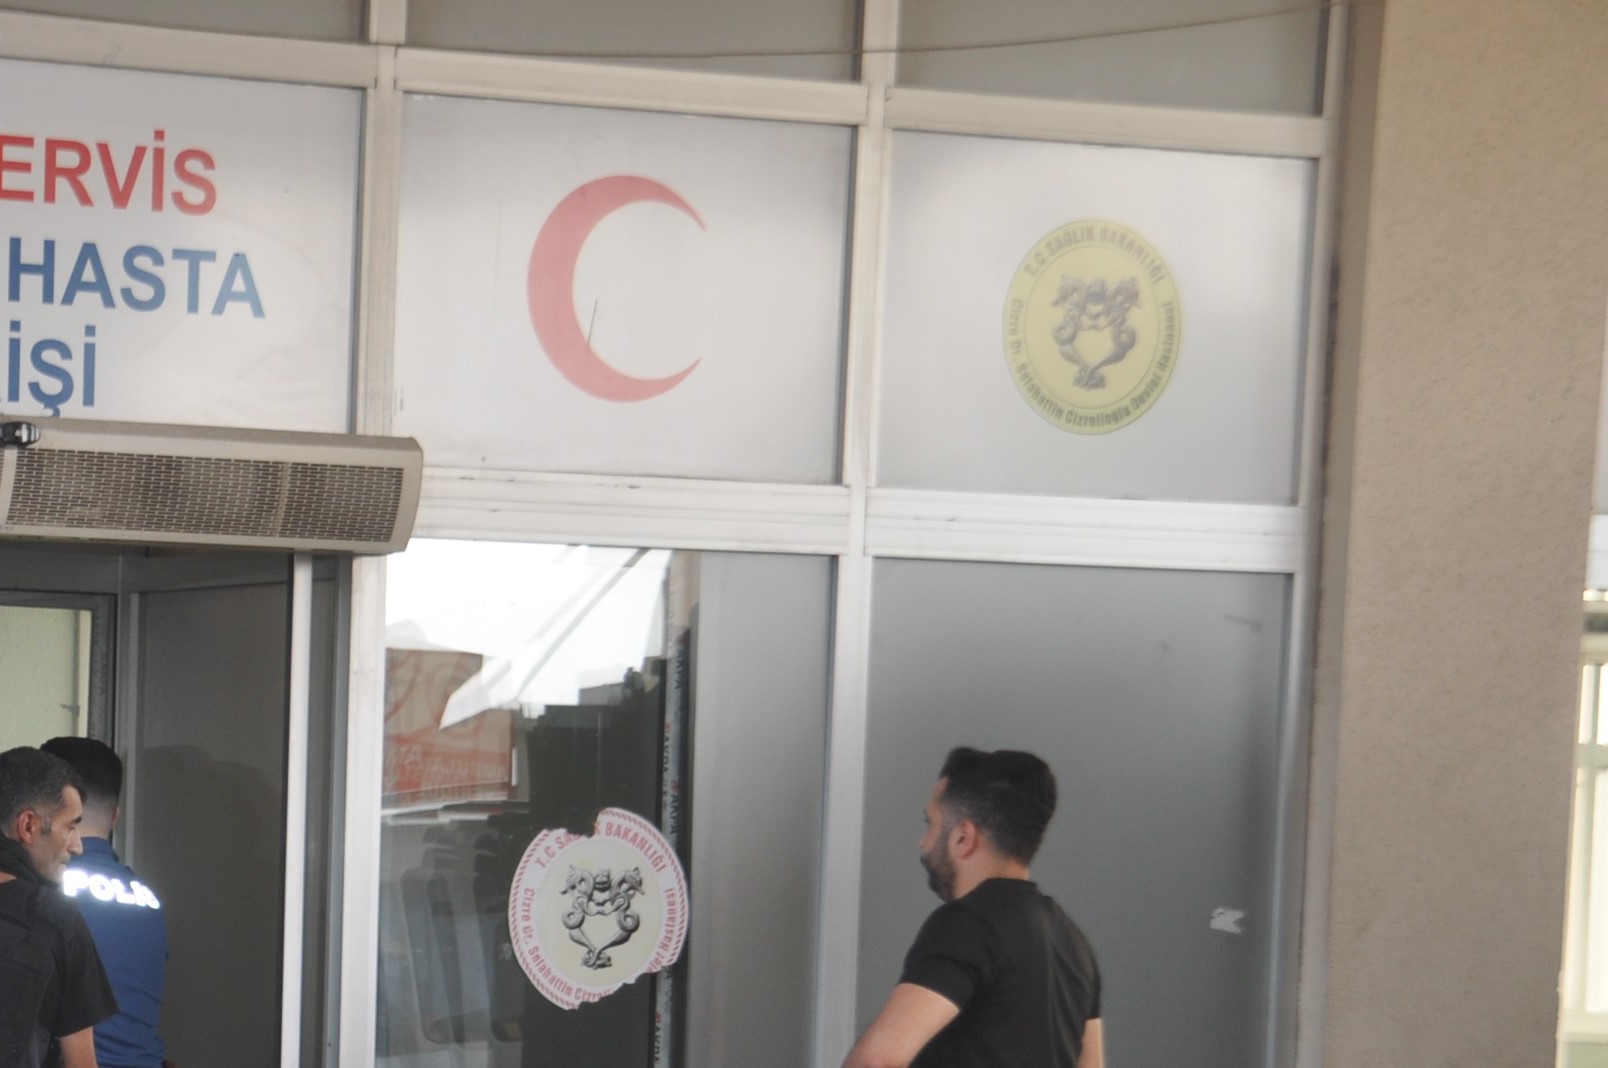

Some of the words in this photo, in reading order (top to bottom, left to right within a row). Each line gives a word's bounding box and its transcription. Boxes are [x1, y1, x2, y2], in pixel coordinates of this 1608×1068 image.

[8, 236, 266, 319] HASTA
[605, 822, 667, 873] BAKANLIĞI
[62, 869, 161, 910] POLİS
[658, 887, 676, 952] Hastanesi
